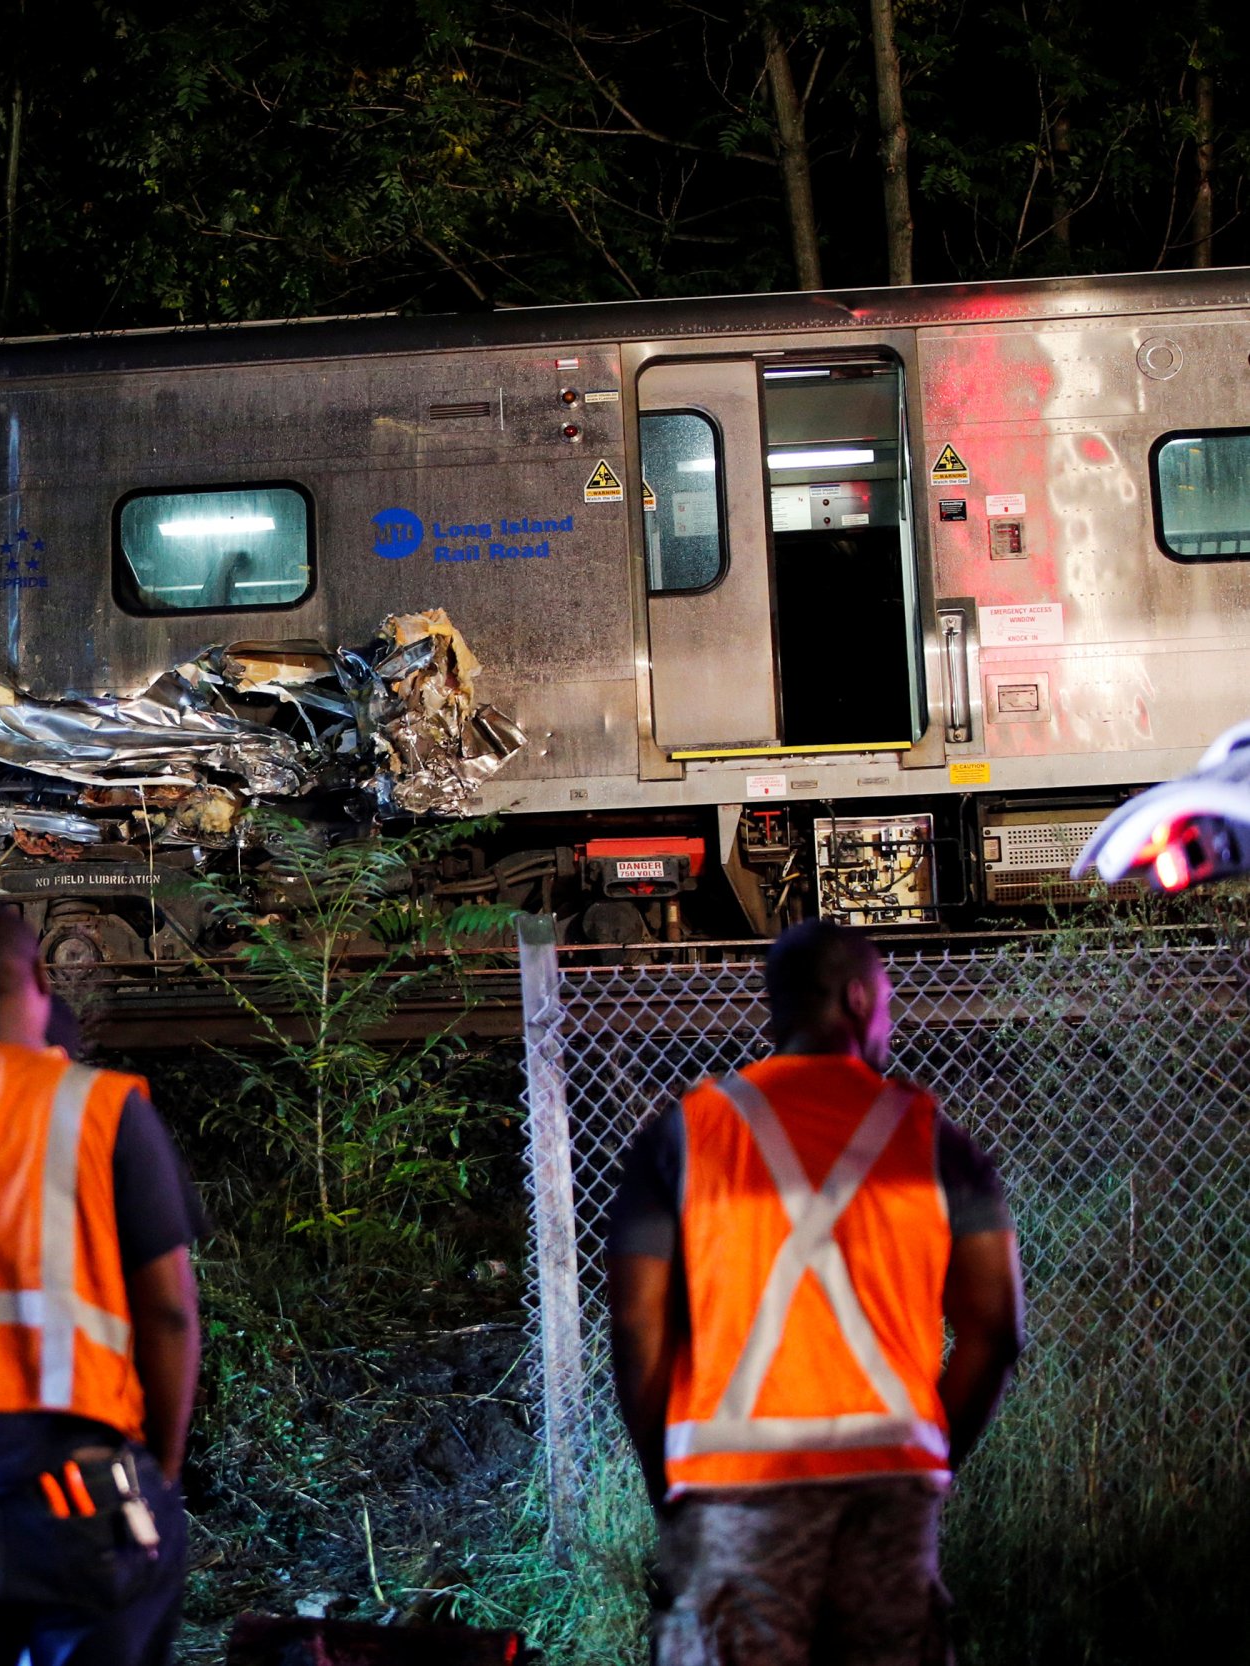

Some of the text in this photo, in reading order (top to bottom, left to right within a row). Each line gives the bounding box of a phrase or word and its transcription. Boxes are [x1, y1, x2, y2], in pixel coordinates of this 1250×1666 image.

[432, 515, 574, 540] Long Island
[433, 540, 550, 563] Rail Road
[3, 575, 49, 590] PRIDE
[990, 607, 1027, 616] EMERGENCY
[619, 861, 662, 870] DANGER
[619, 869, 663, 878] 750 VOLTS
[35, 874, 161, 888] NO FIELD LUBRICATION
